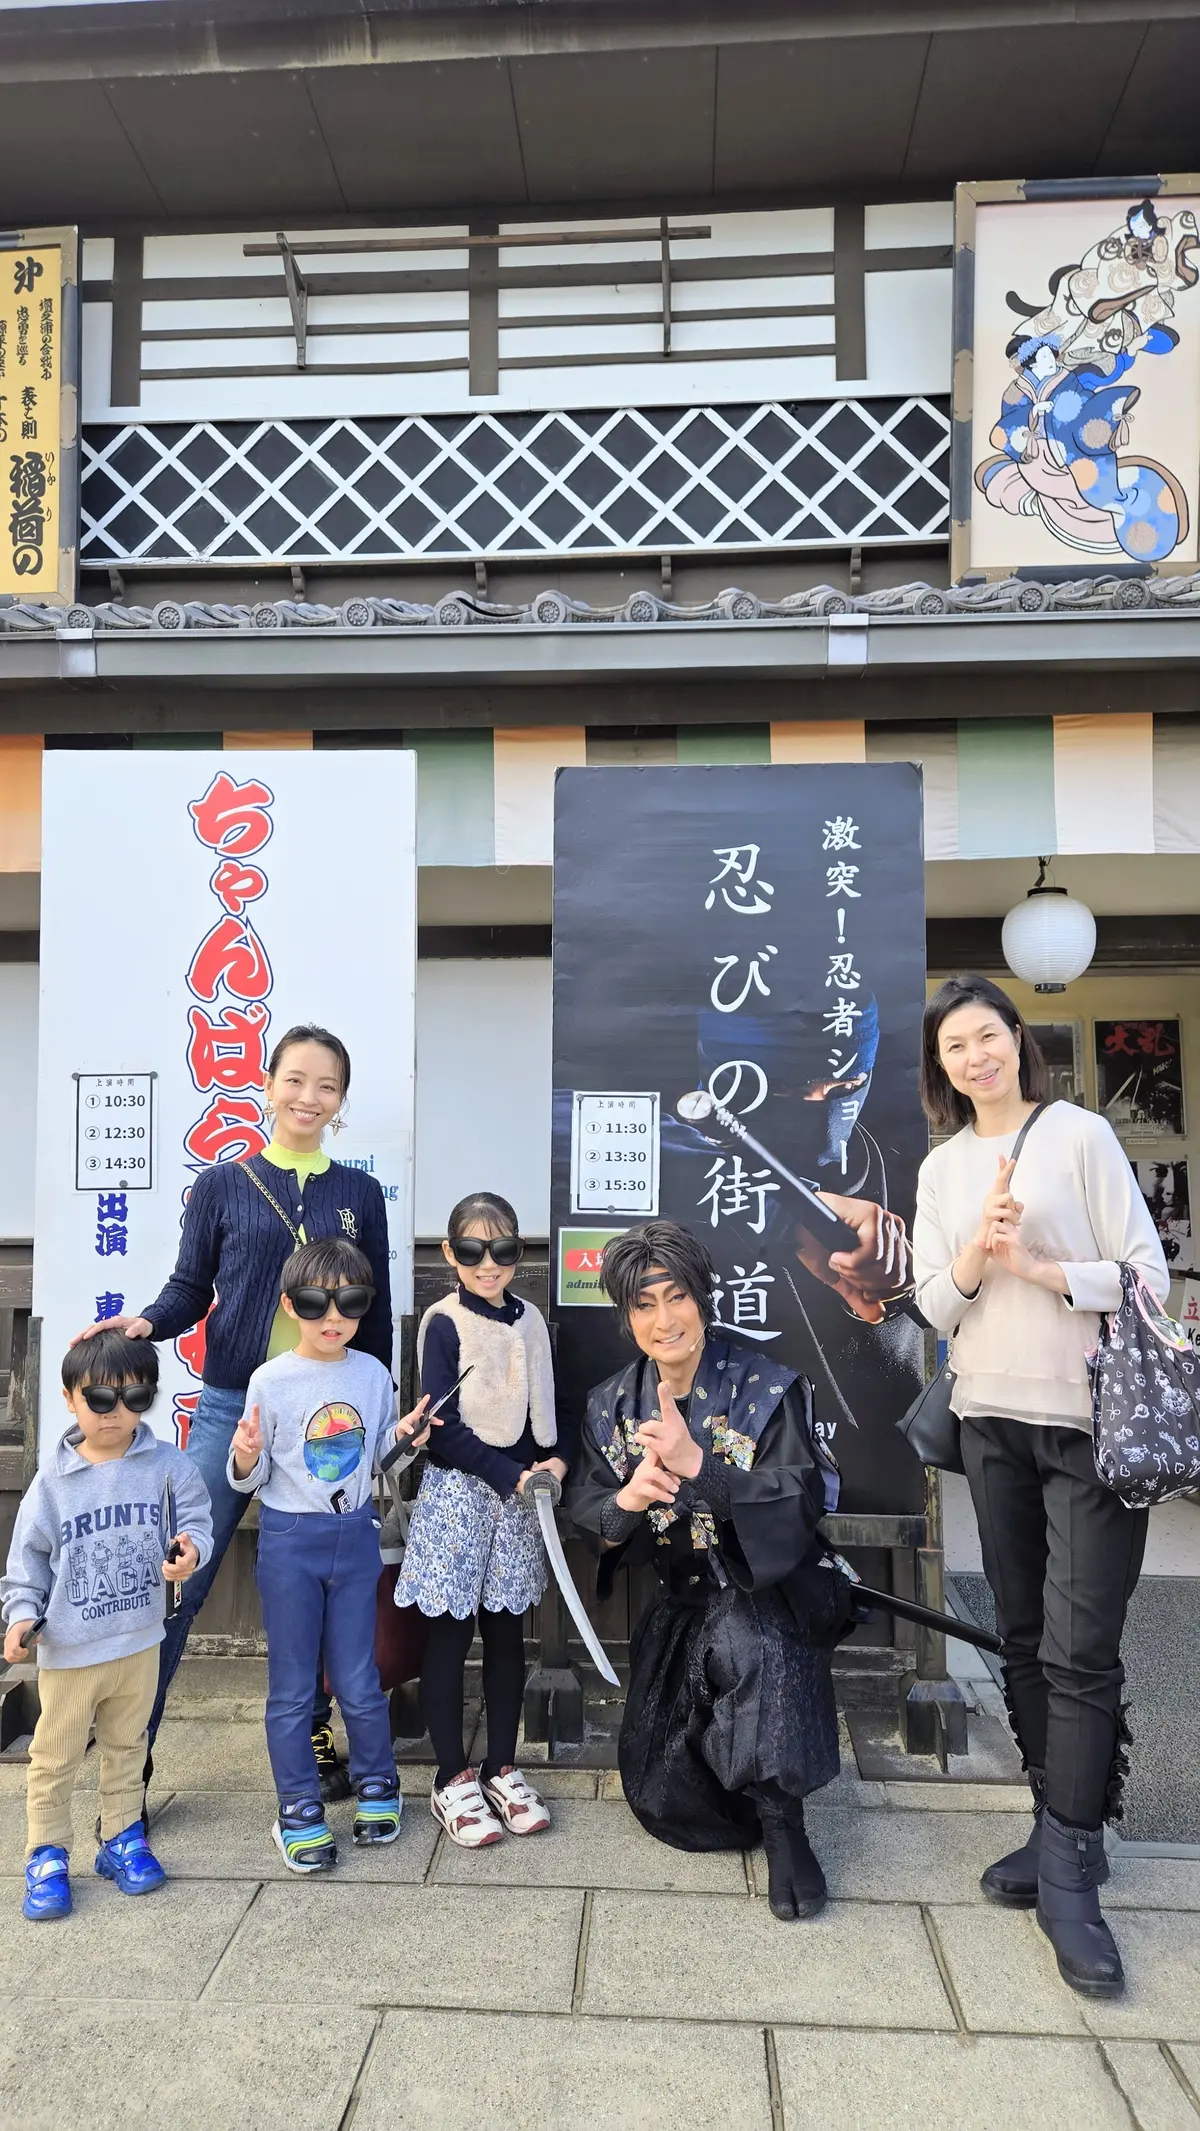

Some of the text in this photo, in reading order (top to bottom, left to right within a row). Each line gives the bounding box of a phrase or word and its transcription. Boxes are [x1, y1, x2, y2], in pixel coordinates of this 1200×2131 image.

[96, 1079, 135, 1087] 上演時間
[697, 843, 782, 1342] 忍びの街道
[105, 1095, 145, 1107] 10:30
[598, 1101, 636, 1109] 上演時間
[105, 1127, 145, 1139] 12:30
[606, 1123, 647, 1134] 11:30
[605, 1151, 646, 1162] 13:30
[105, 1157, 145, 1169] 14:30
[605, 1180, 646, 1191] 15:30
[95, 1193, 128, 1256] 出演
[82, 1592, 150, 1621] CONTRIBUTE
